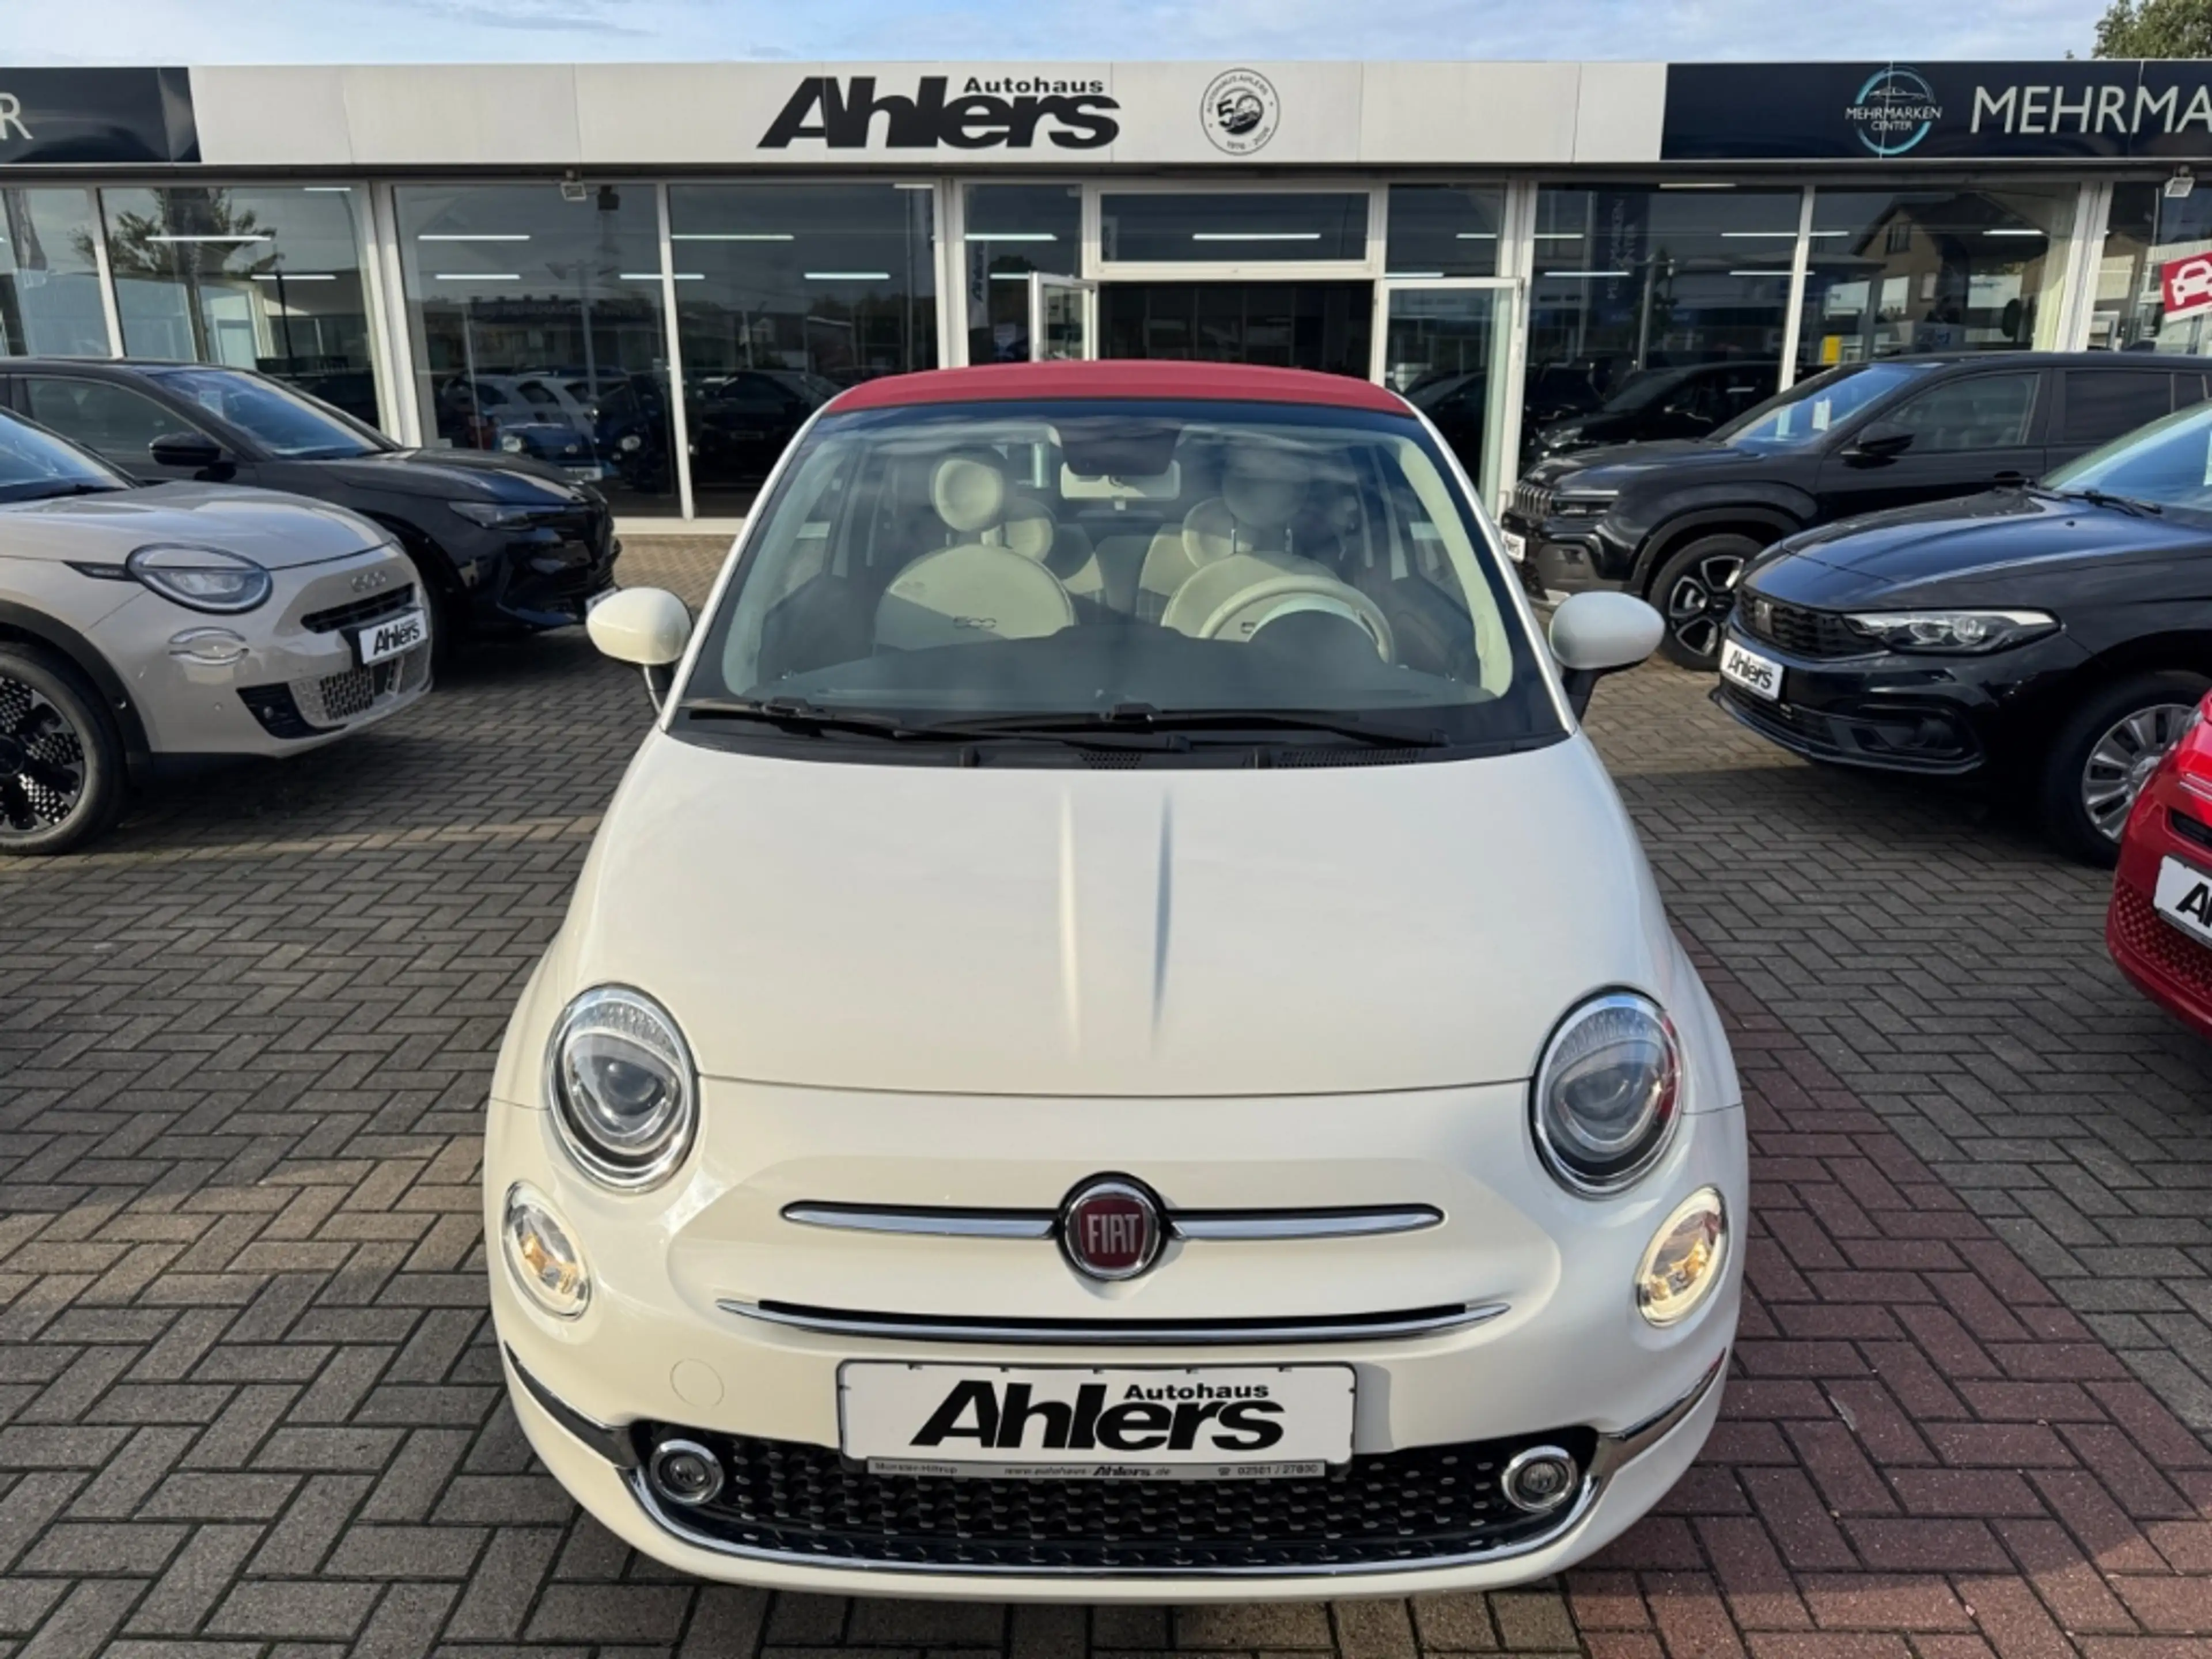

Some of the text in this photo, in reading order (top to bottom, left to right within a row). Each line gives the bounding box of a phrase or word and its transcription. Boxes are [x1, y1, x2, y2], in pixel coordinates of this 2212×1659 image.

[964, 77, 1104, 93] Autohaus
[756, 76, 1121, 149] Ahlers
[1845, 106, 1942, 120] MEHRMARKEN
[1871, 120, 1912, 131] CENTER
[1970, 85, 2212, 134] MEHRMA
[374, 624, 421, 656] Ahlers
[1728, 650, 1772, 690] Ahlers
[1086, 1214, 1139, 1254] FIAT
[1124, 1384, 1269, 1400] Autohaus
[909, 1380, 1285, 1452] Ahlers
